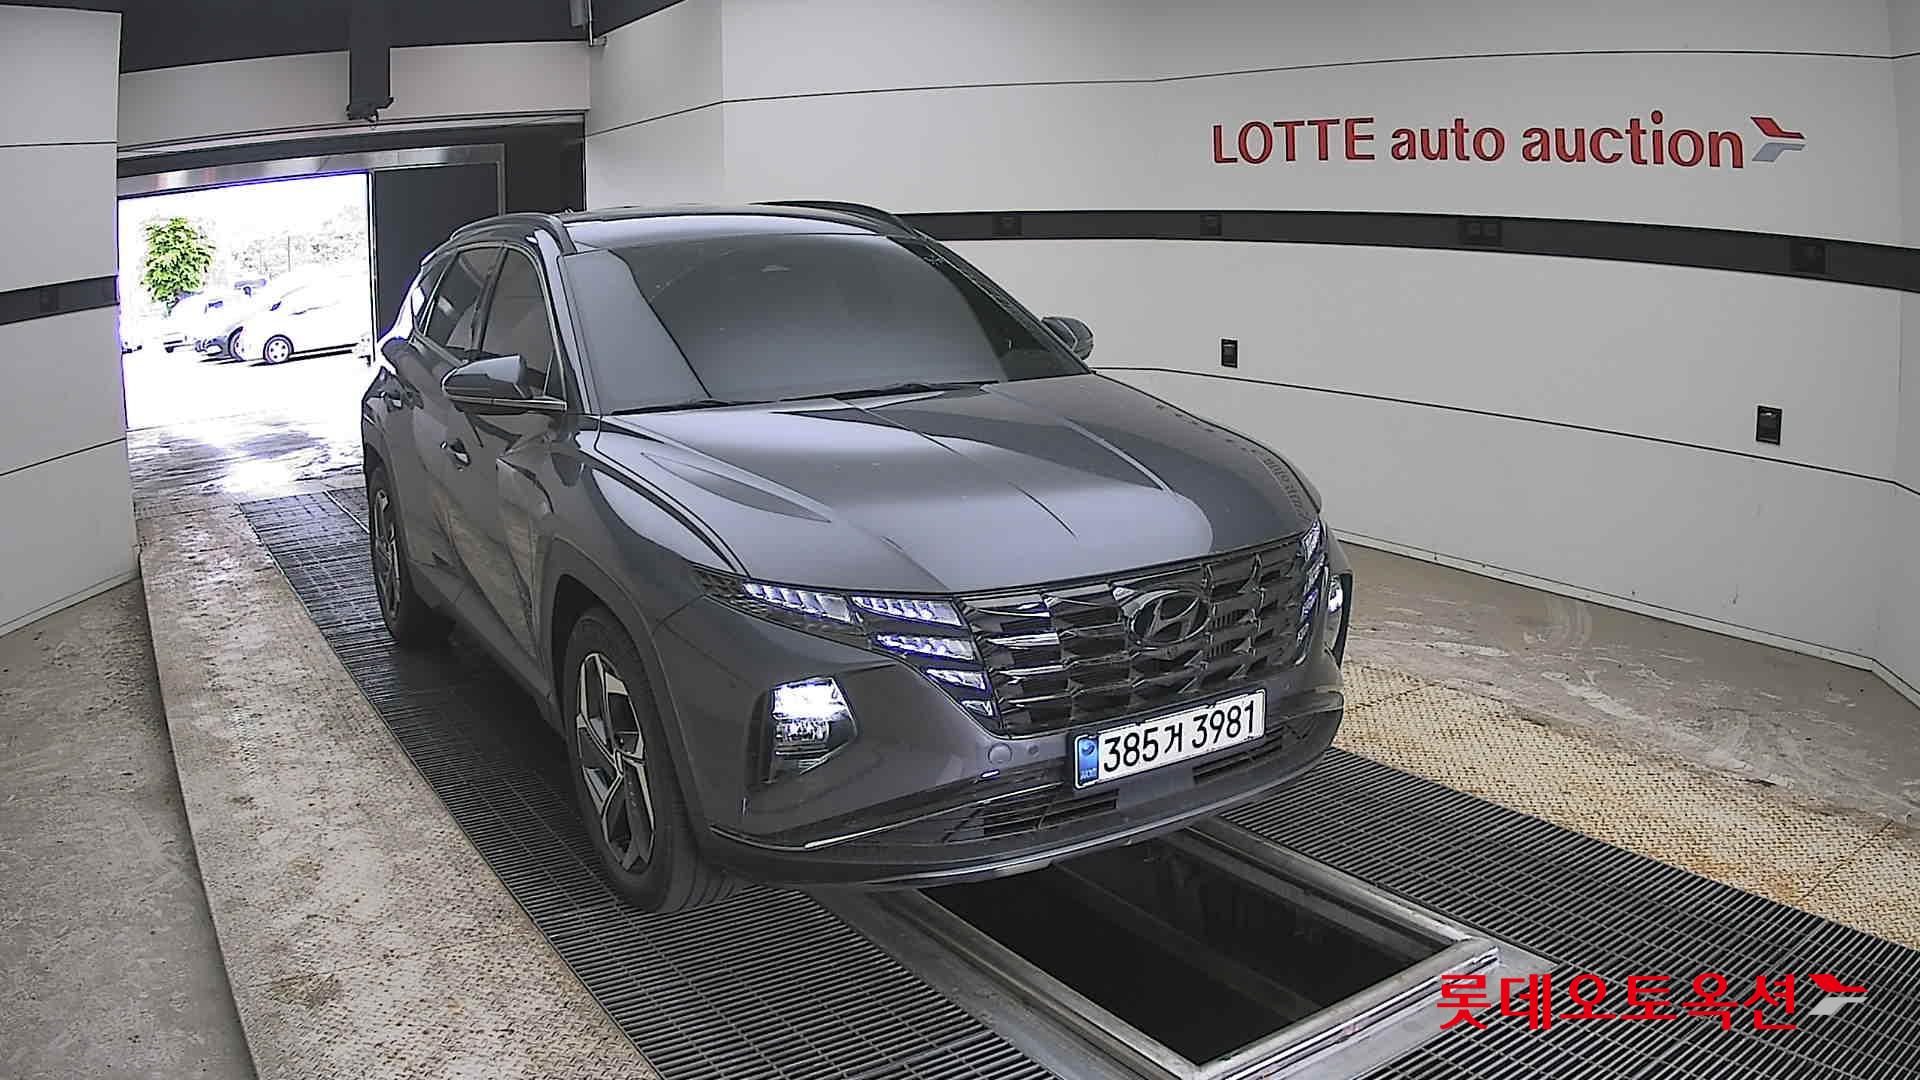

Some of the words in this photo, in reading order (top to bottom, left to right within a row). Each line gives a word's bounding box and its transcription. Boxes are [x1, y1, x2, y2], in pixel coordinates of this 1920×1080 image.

[1213, 117, 1375, 164] LOTTE
[1391, 118, 1505, 161] auto
[1521, 110, 1744, 169] auction
[1191, 700, 1255, 749] 3981
